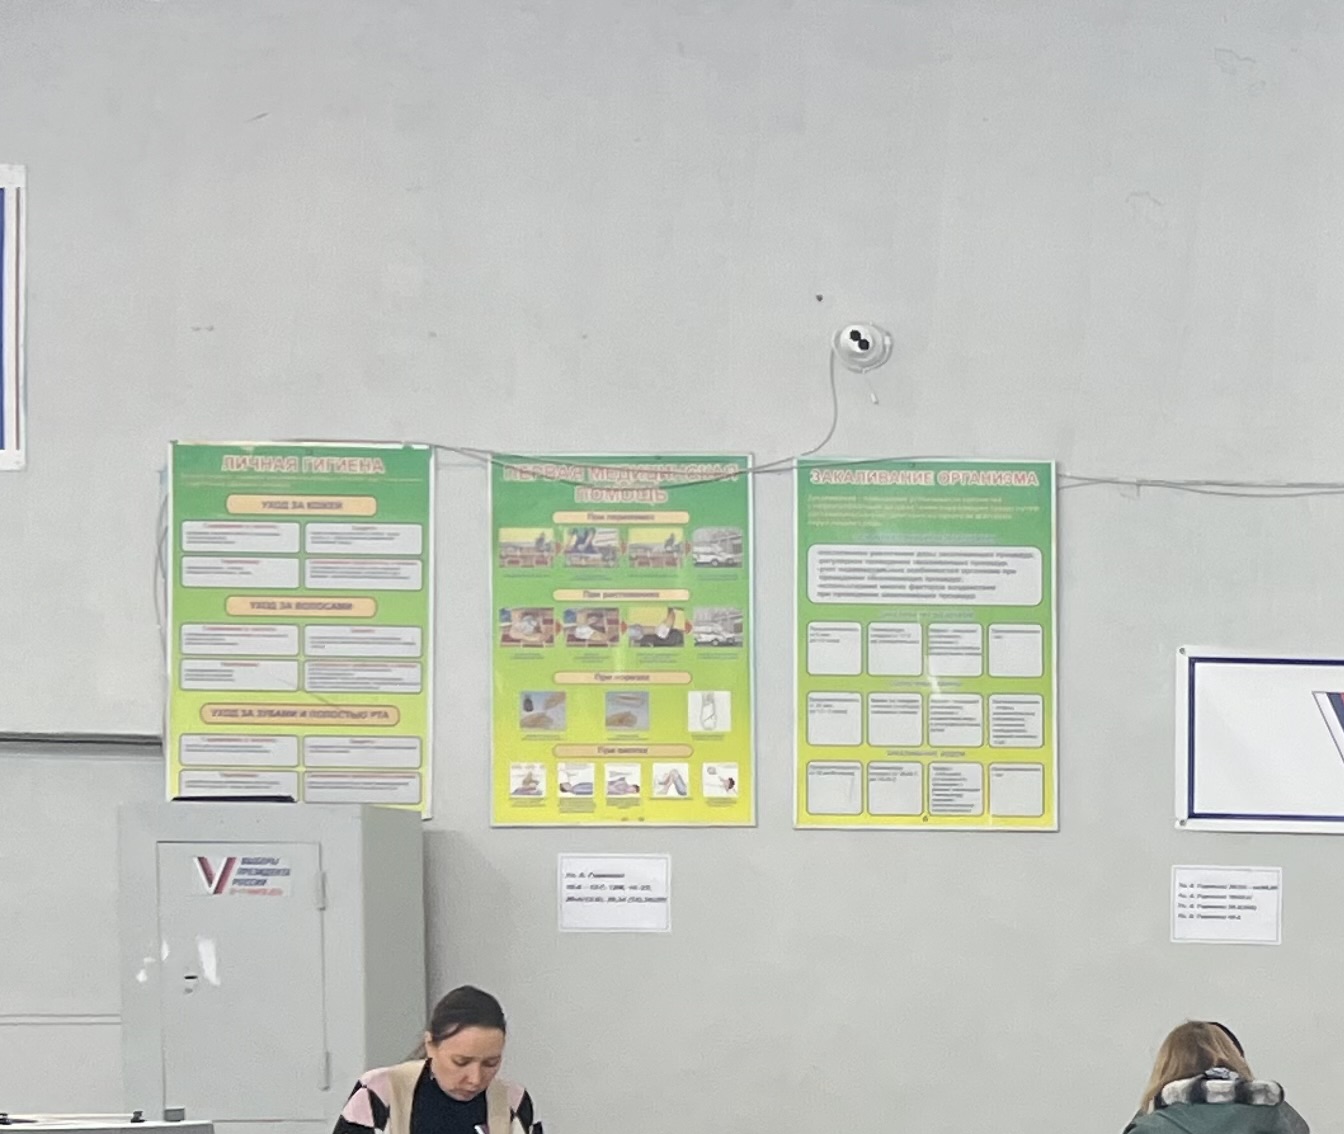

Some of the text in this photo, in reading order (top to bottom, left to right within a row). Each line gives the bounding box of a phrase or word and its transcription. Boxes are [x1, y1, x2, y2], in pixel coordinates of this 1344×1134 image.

[221, 455, 385, 474] ЛИЧНАЯ ГИГИЕНА
[810, 469, 1039, 487] ЗАКАЛИВАНИЕ ОРГАНИЗМА
[575, 487, 668, 506] ПОМОЩЬ
